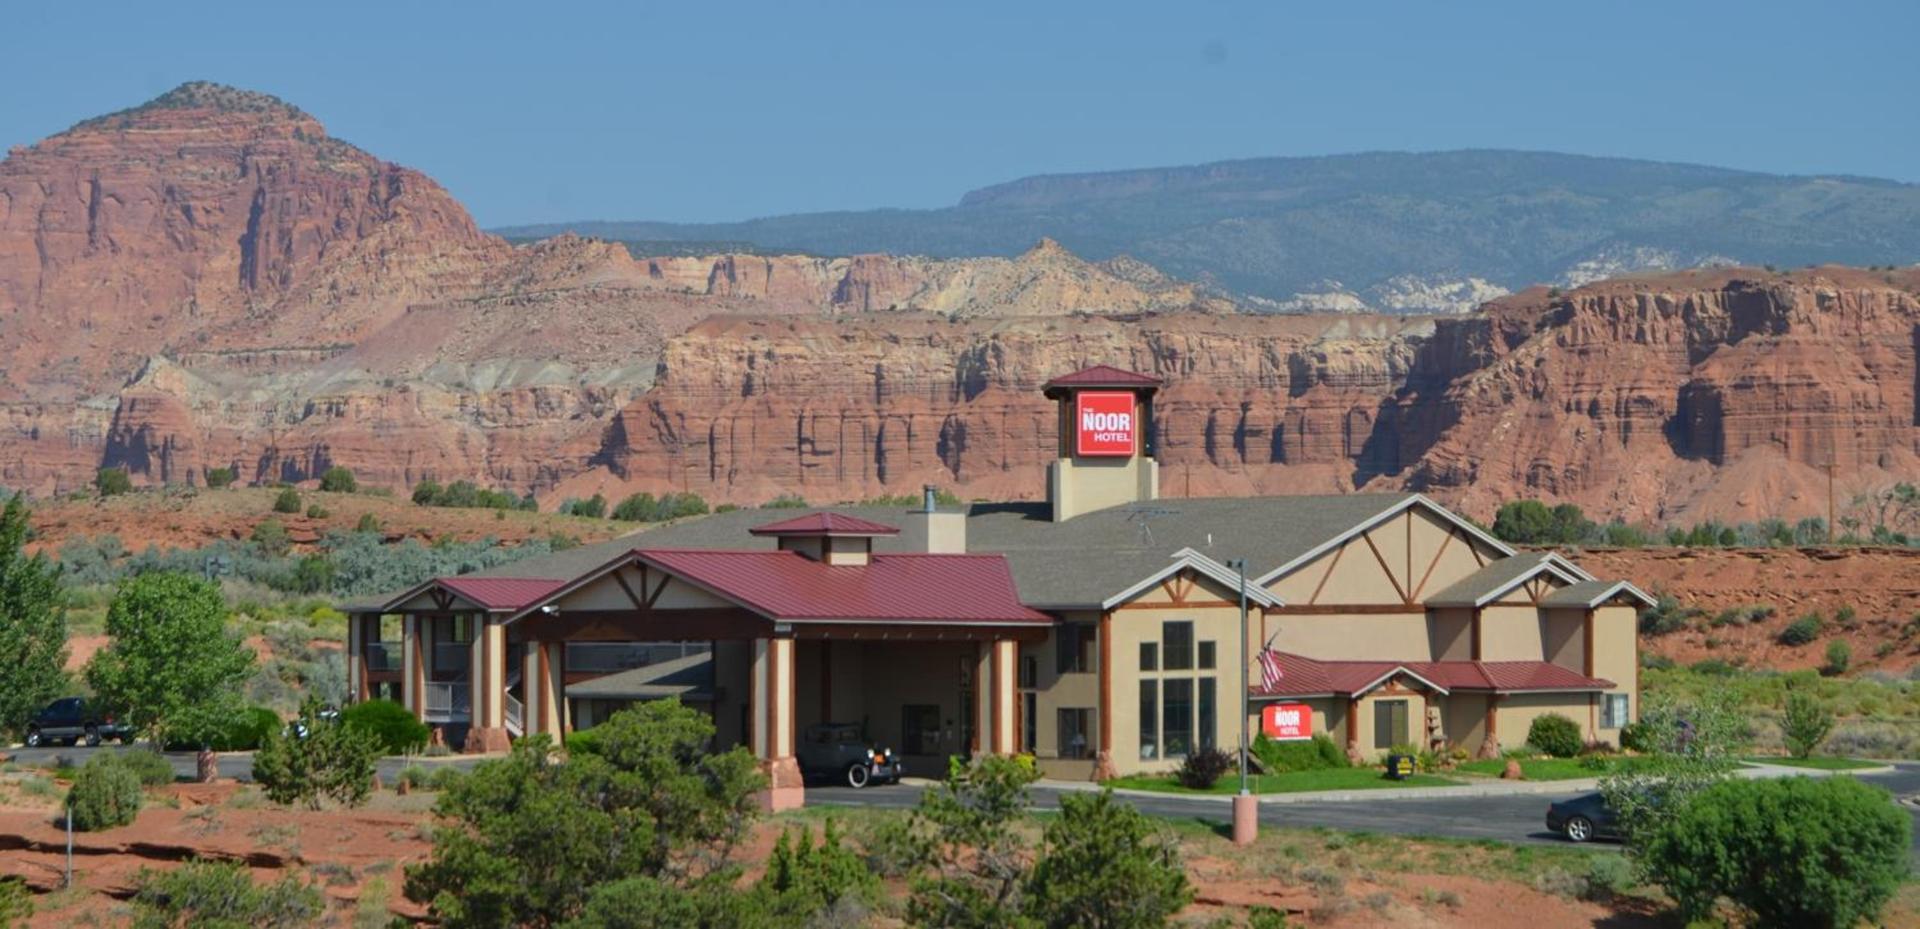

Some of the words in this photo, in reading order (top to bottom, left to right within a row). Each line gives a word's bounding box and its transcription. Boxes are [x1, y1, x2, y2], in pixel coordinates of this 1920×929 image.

[1083, 412, 1130, 431] NOOR
[1094, 432, 1131, 442] HOTEL
[1275, 711, 1300, 726] NOOR
